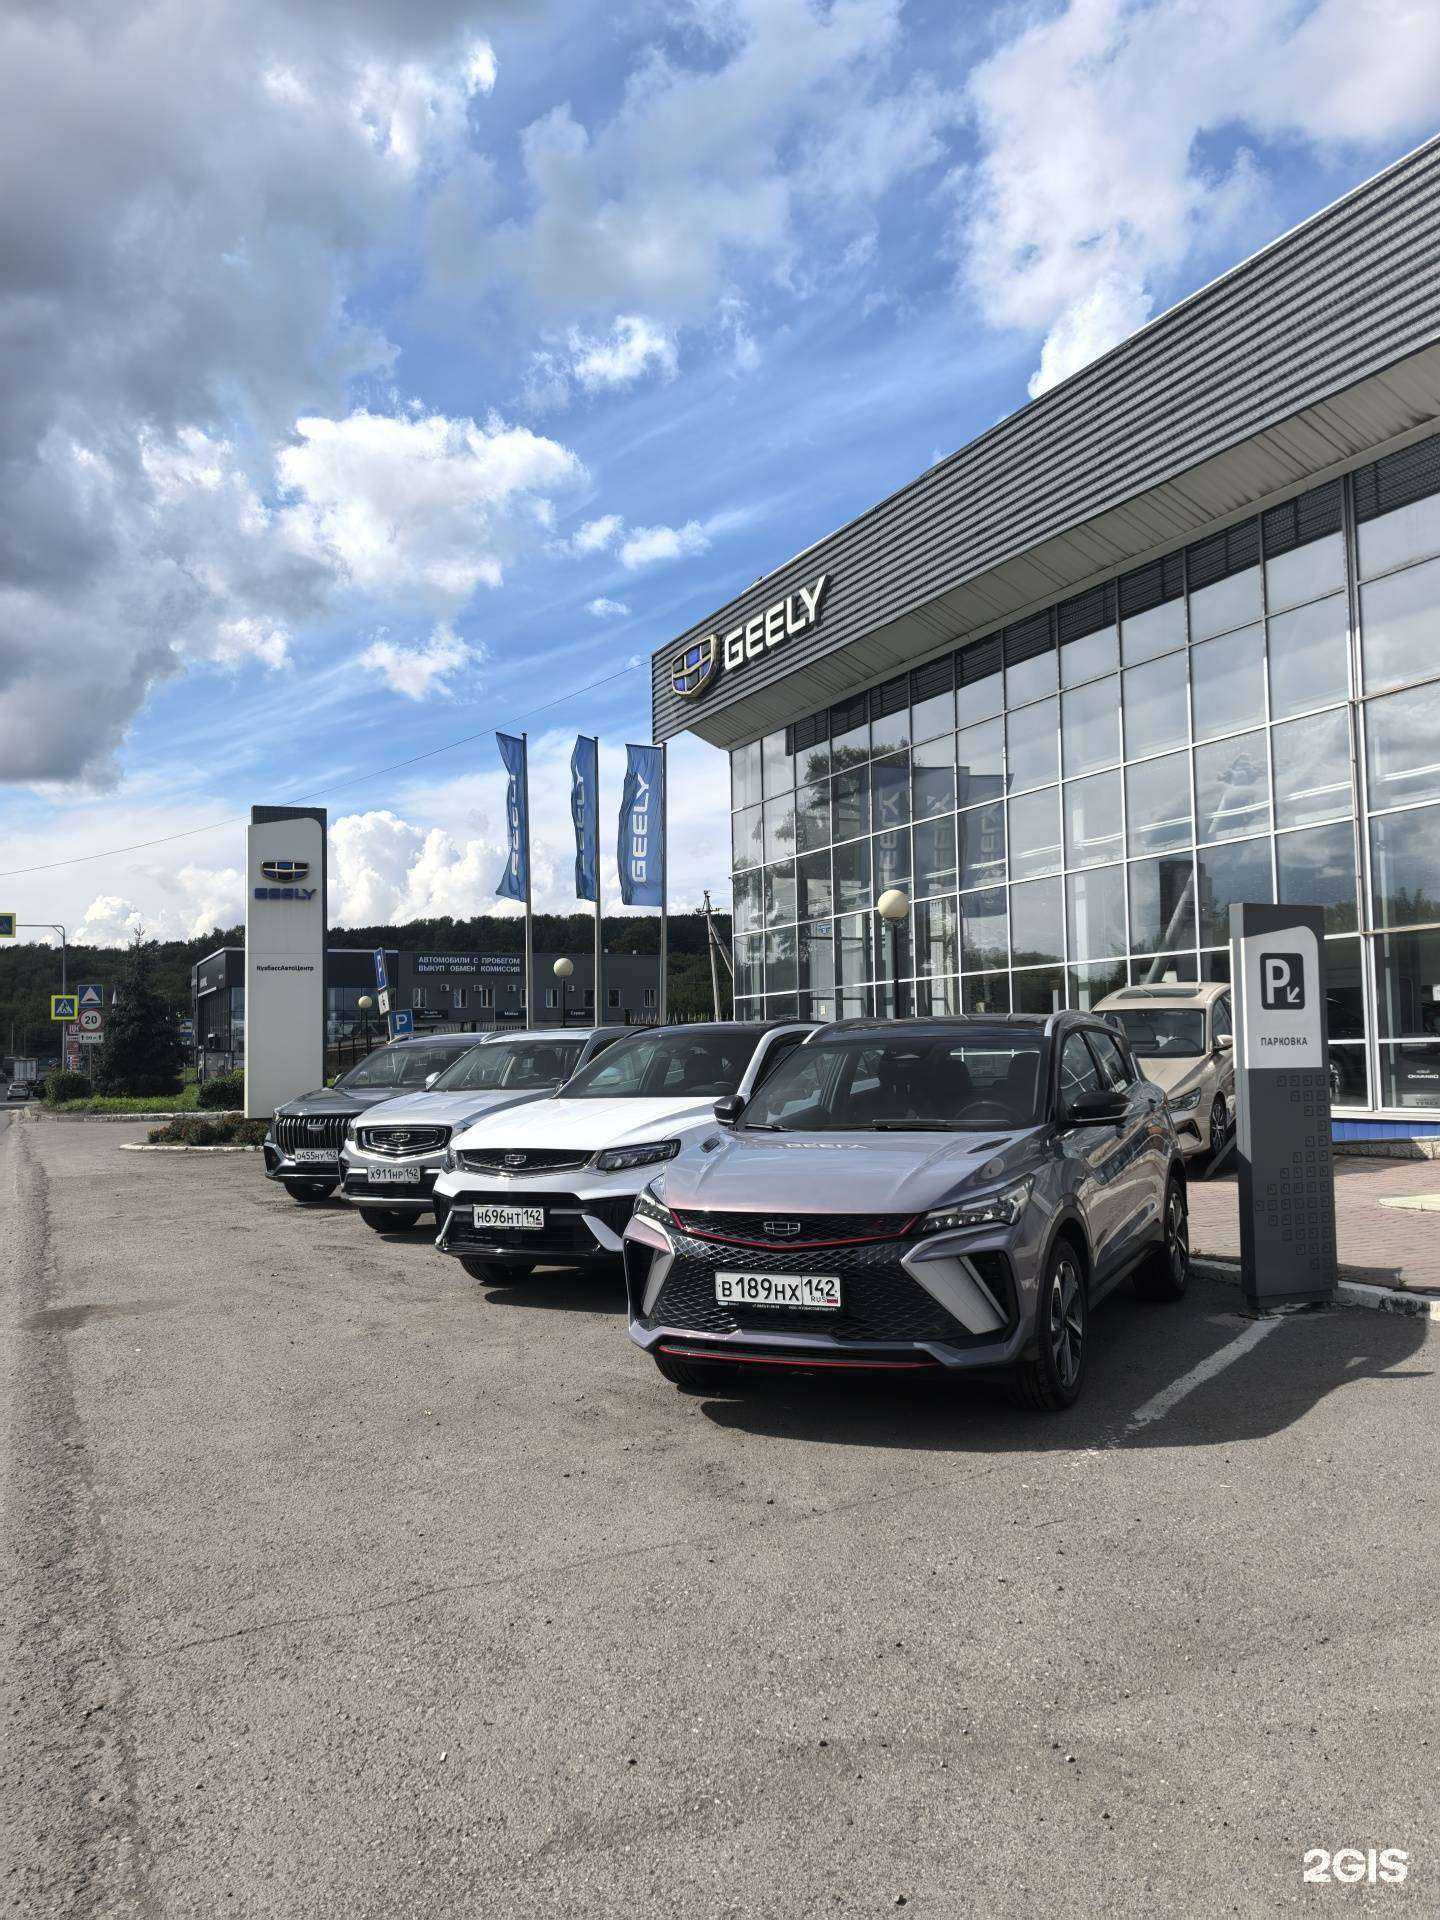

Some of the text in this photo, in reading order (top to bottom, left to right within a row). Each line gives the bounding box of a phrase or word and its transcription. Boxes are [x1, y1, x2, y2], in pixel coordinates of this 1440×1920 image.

[724, 574, 827, 670] GEELY
[631, 773, 650, 883] GEELY
[418, 956, 470, 964] АВТОМОБИЛИ
[480, 965, 520, 973] КОМИССИЯ
[1265, 958, 1291, 1004] P
[84, 1016, 98, 1025] 20
[396, 1014, 408, 1030] P
[1261, 1037, 1308, 1046] ПАРКОВКА
[405, 1168, 418, 1178] 142
[477, 1209, 541, 1224] Н696НТ 142
[721, 1276, 836, 1301] В189НХ 142
